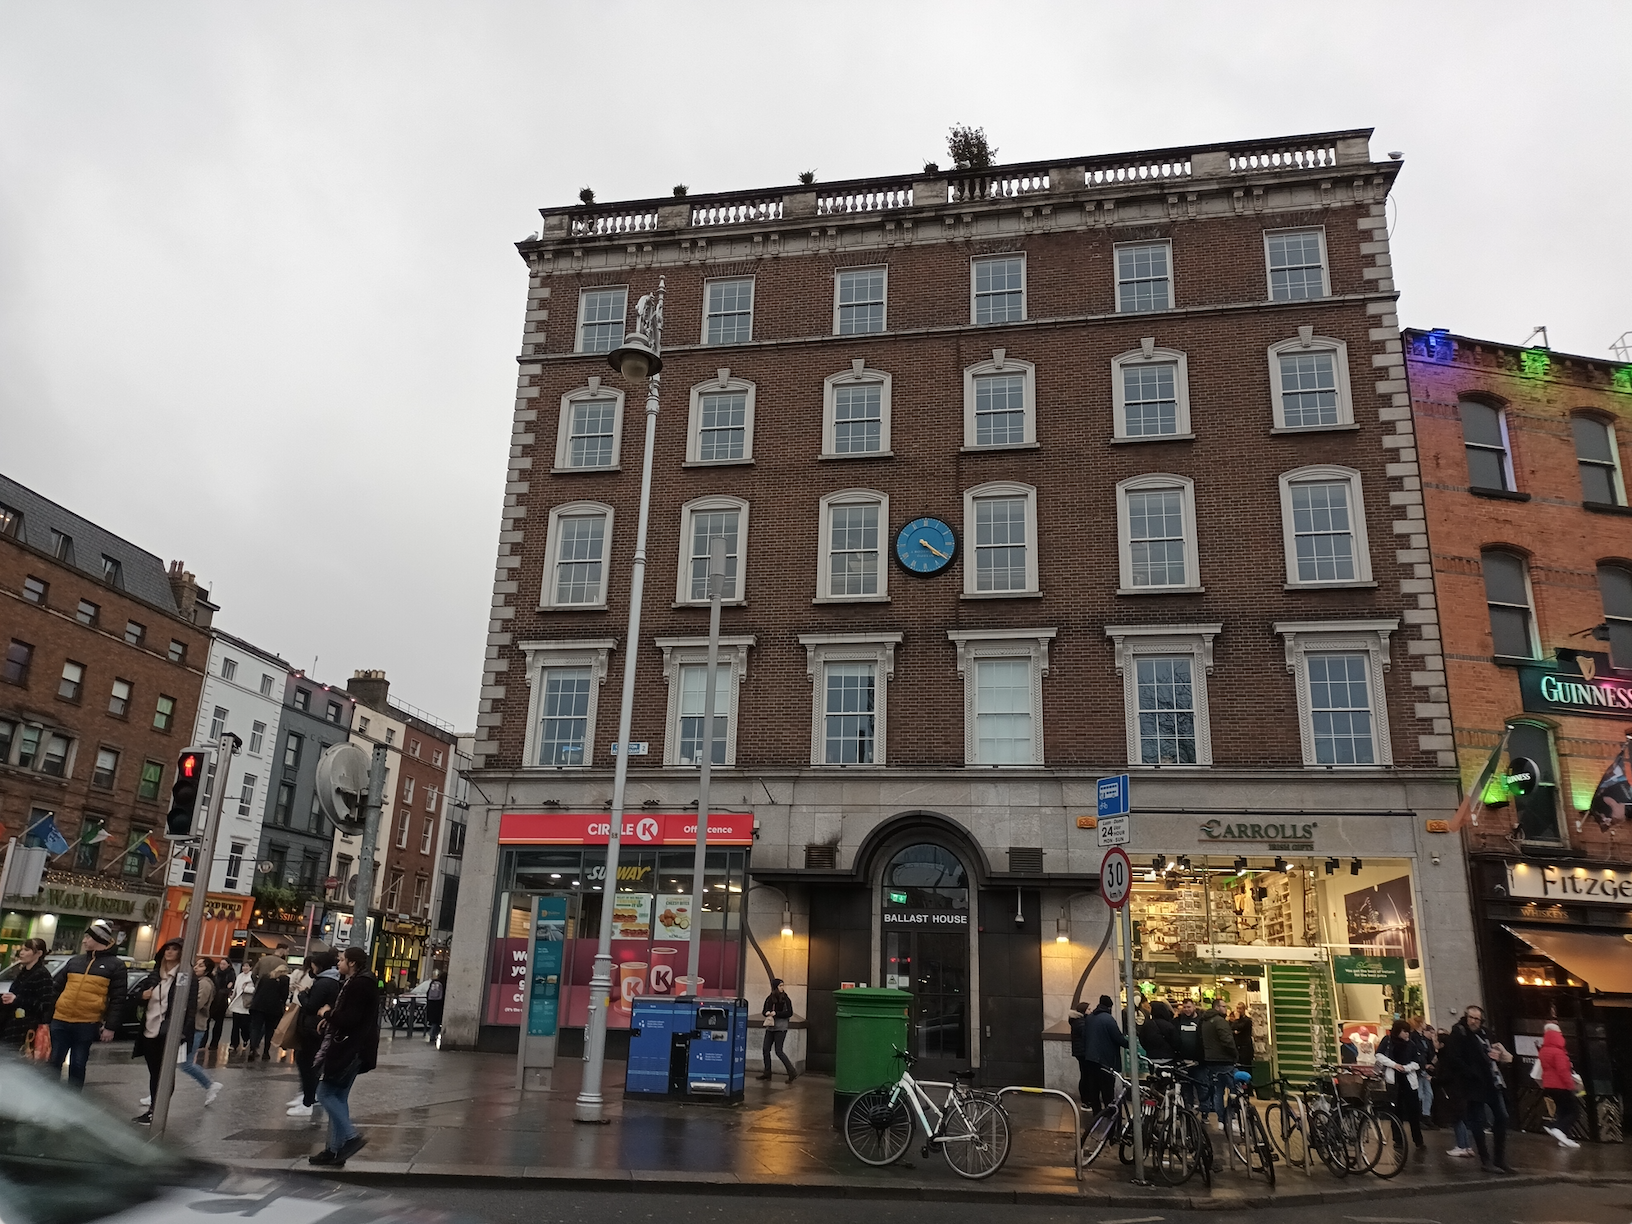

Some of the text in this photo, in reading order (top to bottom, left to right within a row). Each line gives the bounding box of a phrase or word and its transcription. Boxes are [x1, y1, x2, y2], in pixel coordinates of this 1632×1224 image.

[588, 823, 634, 836] CIRLE
[1102, 826, 1113, 838] 24
[1200, 819, 1313, 839] CARROLLS
[1268, 843, 1315, 851] IRISH GIFTS
[587, 866, 651, 881] SUWAY
[1107, 862, 1124, 888] 30
[1109, 890, 1123, 899] km/h
[80, 891, 137, 915] MUSEUM
[221, 902, 242, 912] WORLD
[884, 913, 968, 924] BALLAST HOUSE
[1521, 908, 1569, 919] WHISKEYS
